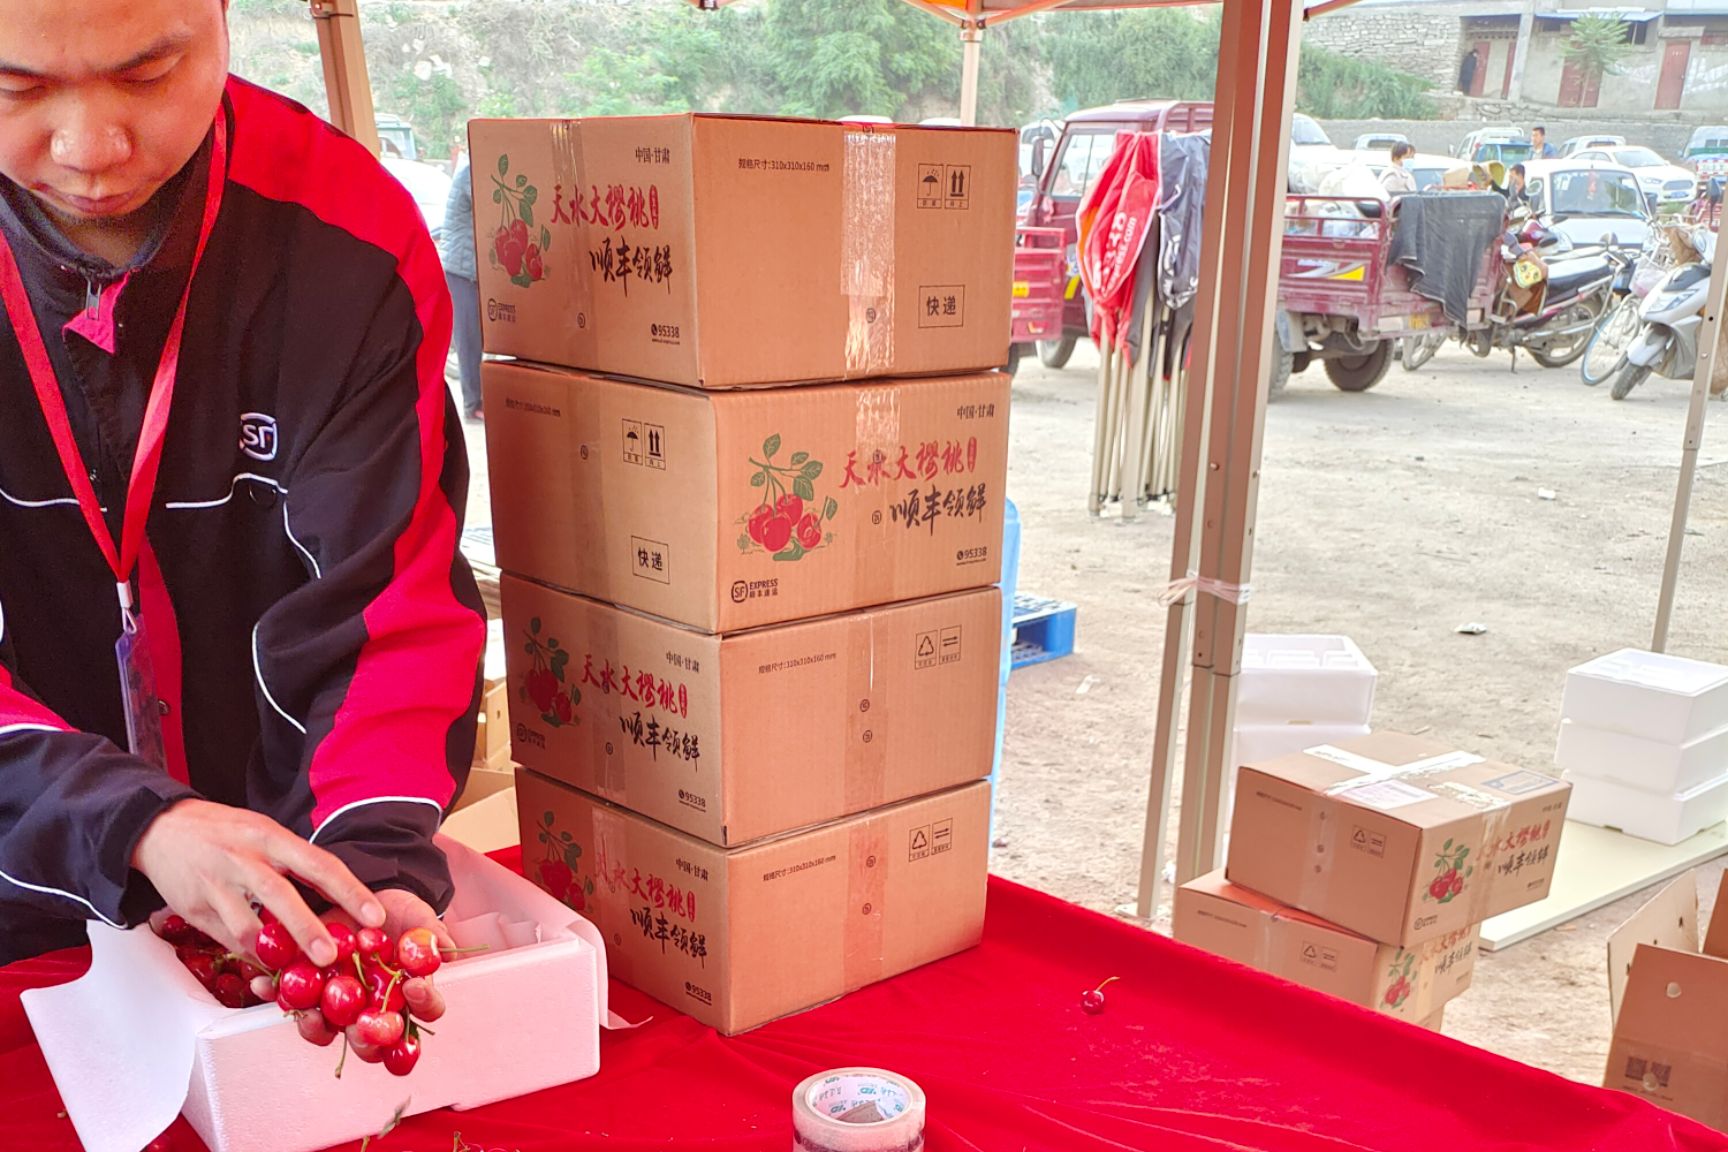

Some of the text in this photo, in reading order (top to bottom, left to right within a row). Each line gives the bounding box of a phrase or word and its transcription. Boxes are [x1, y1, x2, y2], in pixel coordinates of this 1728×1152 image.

[589, 235, 673, 297] 顺丰领鲜
[926, 295, 956, 317] 快递
[657, 325, 680, 338] 95338
[889, 482, 986, 537] 顺丰领鲜
[638, 547, 663, 571] 快递
[964, 546, 987, 559] 95338
[619, 711, 700, 773] 顺丰领鲜
[685, 791, 706, 807] 95338
[630, 907, 707, 969] 顺丰领鲜
